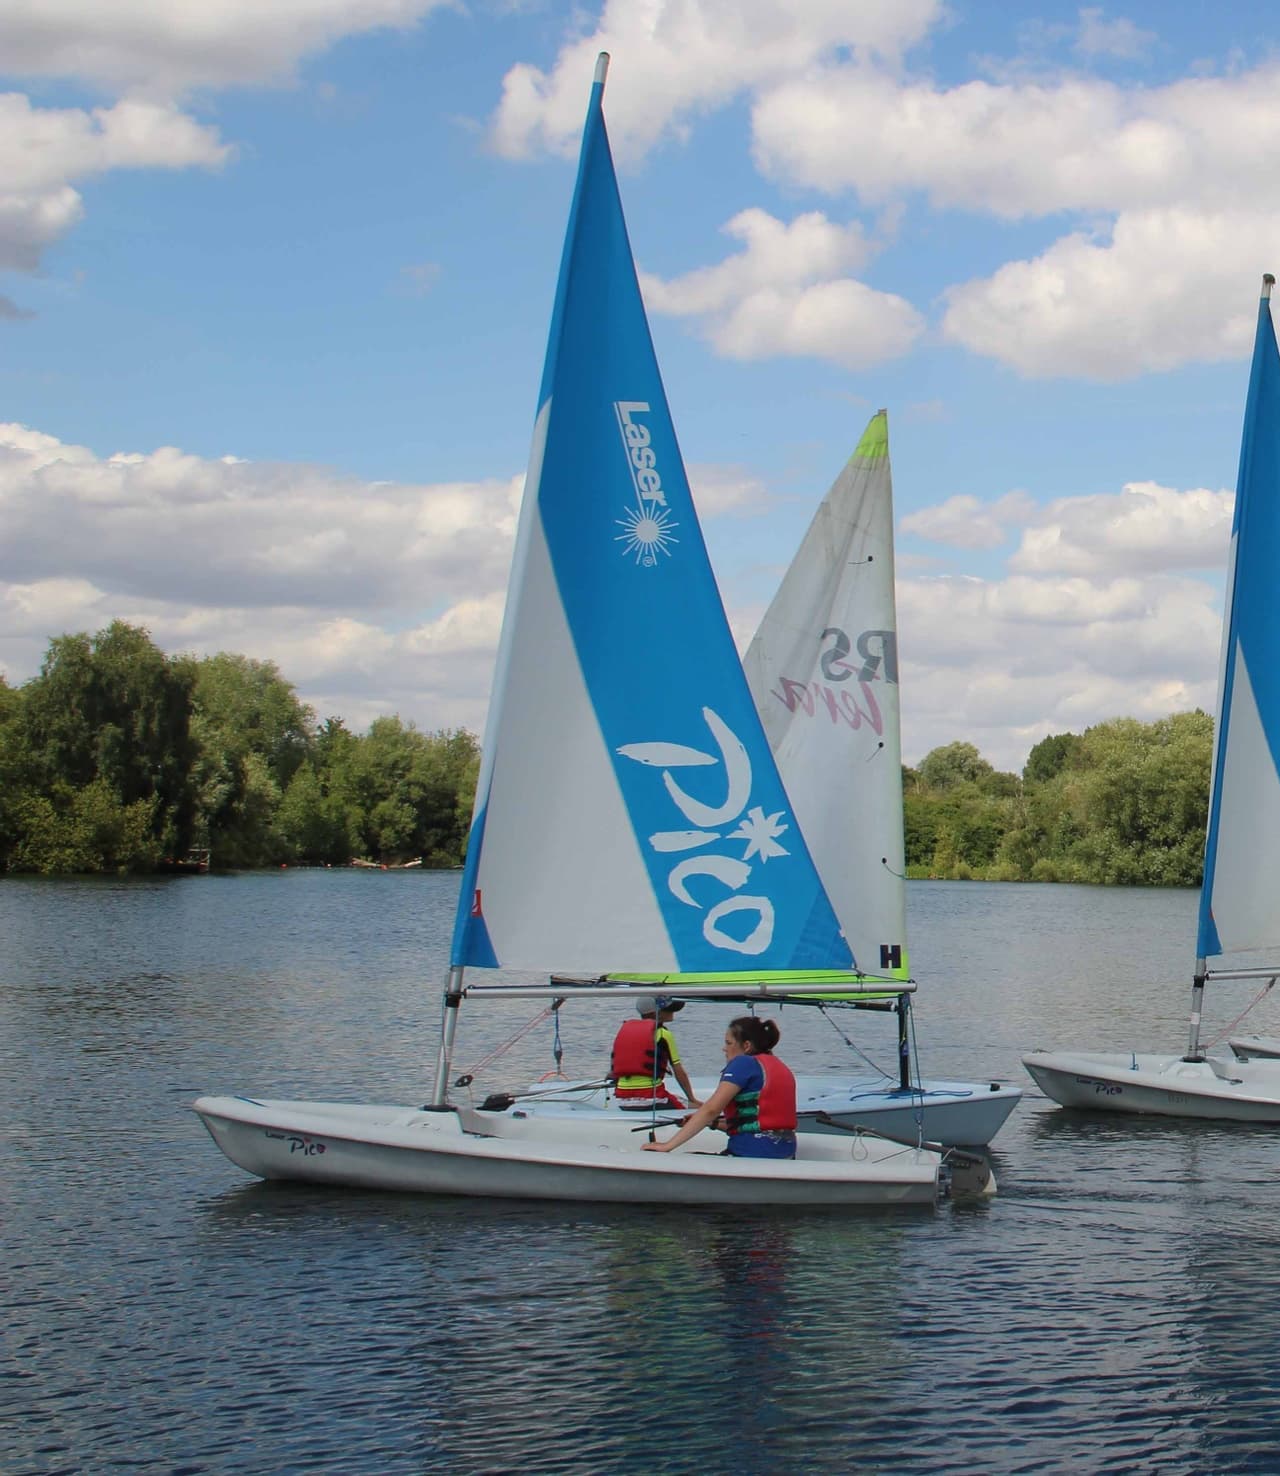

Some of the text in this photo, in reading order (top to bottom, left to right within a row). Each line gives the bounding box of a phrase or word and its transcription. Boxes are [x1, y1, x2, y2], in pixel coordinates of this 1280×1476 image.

[618, 401, 668, 506] Laser
[616, 706, 791, 955] Pico
[287, 1136, 327, 1156] Pico
